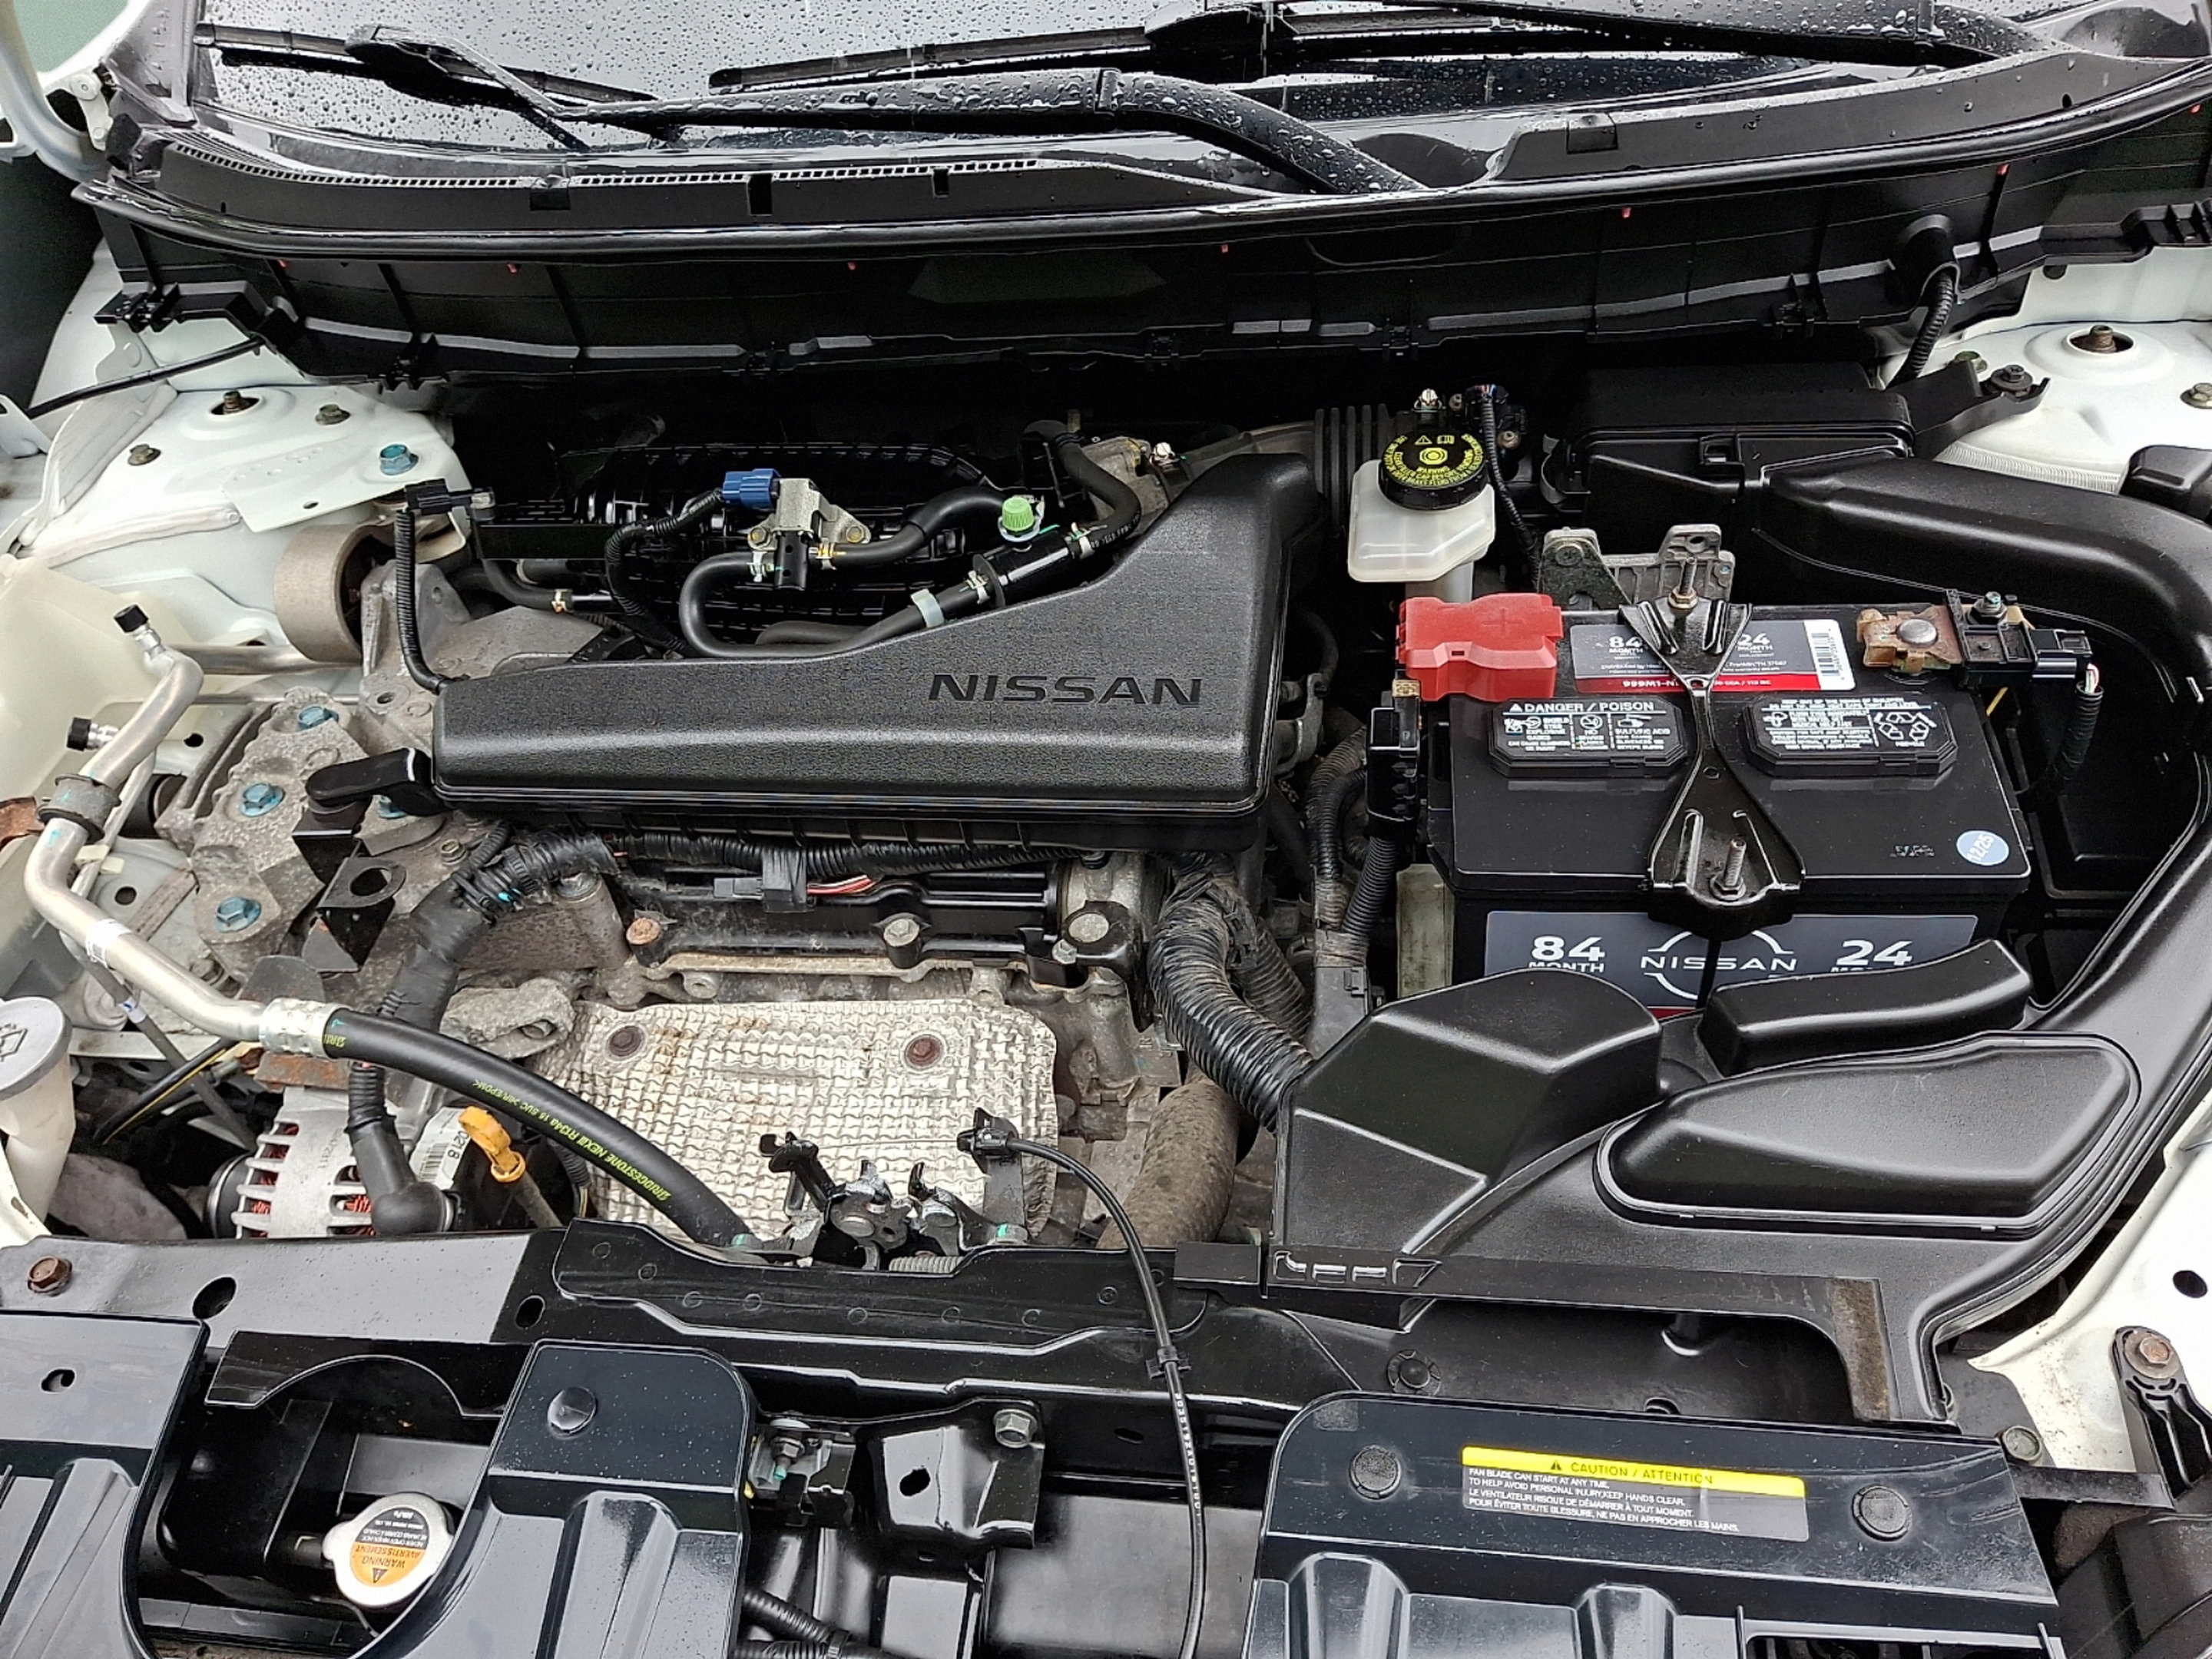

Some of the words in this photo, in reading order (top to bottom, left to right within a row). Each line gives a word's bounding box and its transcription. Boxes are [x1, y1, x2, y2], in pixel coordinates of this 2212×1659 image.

[1608, 635, 1643, 647] 84
[1737, 633, 1770, 646] 24
[928, 673, 1204, 706] NISSAN
[1525, 703, 1584, 713] DANGER
[1599, 701, 1654, 711] POISON
[1531, 935, 1605, 962] 84
[1835, 939, 1912, 966] 24
[1641, 955, 1797, 972] NISSAN
[1469, 1468, 1485, 1477] FAN
[1486, 1469, 1512, 1479] BLADE
[1514, 1472, 1532, 1482] CAN
[1533, 1473, 1558, 1484] START
[1559, 1475, 1569, 1485] AT
[1571, 1476, 1588, 1486] ANY
[1570, 1462, 1628, 1477] CAUTION
[1642, 1469, 1714, 1485] ATTENTION
[1469, 1477, 1480, 1485] TO
[1482, 1478, 1503, 1488] HELP
[1504, 1480, 1528, 1490] AVOID
[1530, 1483, 1573, 1495] PERSONAL
[1625, 1492, 1654, 1503] HANDS
[1656, 1495, 1686, 1506] CLEAR.
[1469, 1487, 1479, 1496] LE
[1481, 1488, 1532, 1502] VENTILATEUR
[1534, 1494, 1565, 1505] RISQUE
[1566, 1497, 1577, 1506] DE
[1578, 1498, 1624, 1511] DÉMARRER
[1633, 1504, 1655, 1514] TOUT
[1469, 1498, 1493, 1508] POUR
[1494, 1498, 1522, 1510] ÉVITER
[1522, 1502, 1549, 1514] TOUTE
[1596, 1511, 1608, 1519] NE
[1609, 1512, 1626, 1522] PAS
[1627, 1513, 1639, 1523] EN
[1640, 1515, 1693, 1528] APPROCHER
[1694, 1520, 1709, 1529] LES
[356, 1545, 422, 1560] AVERTISSEMENT
[362, 1555, 406, 1568] WARNING
